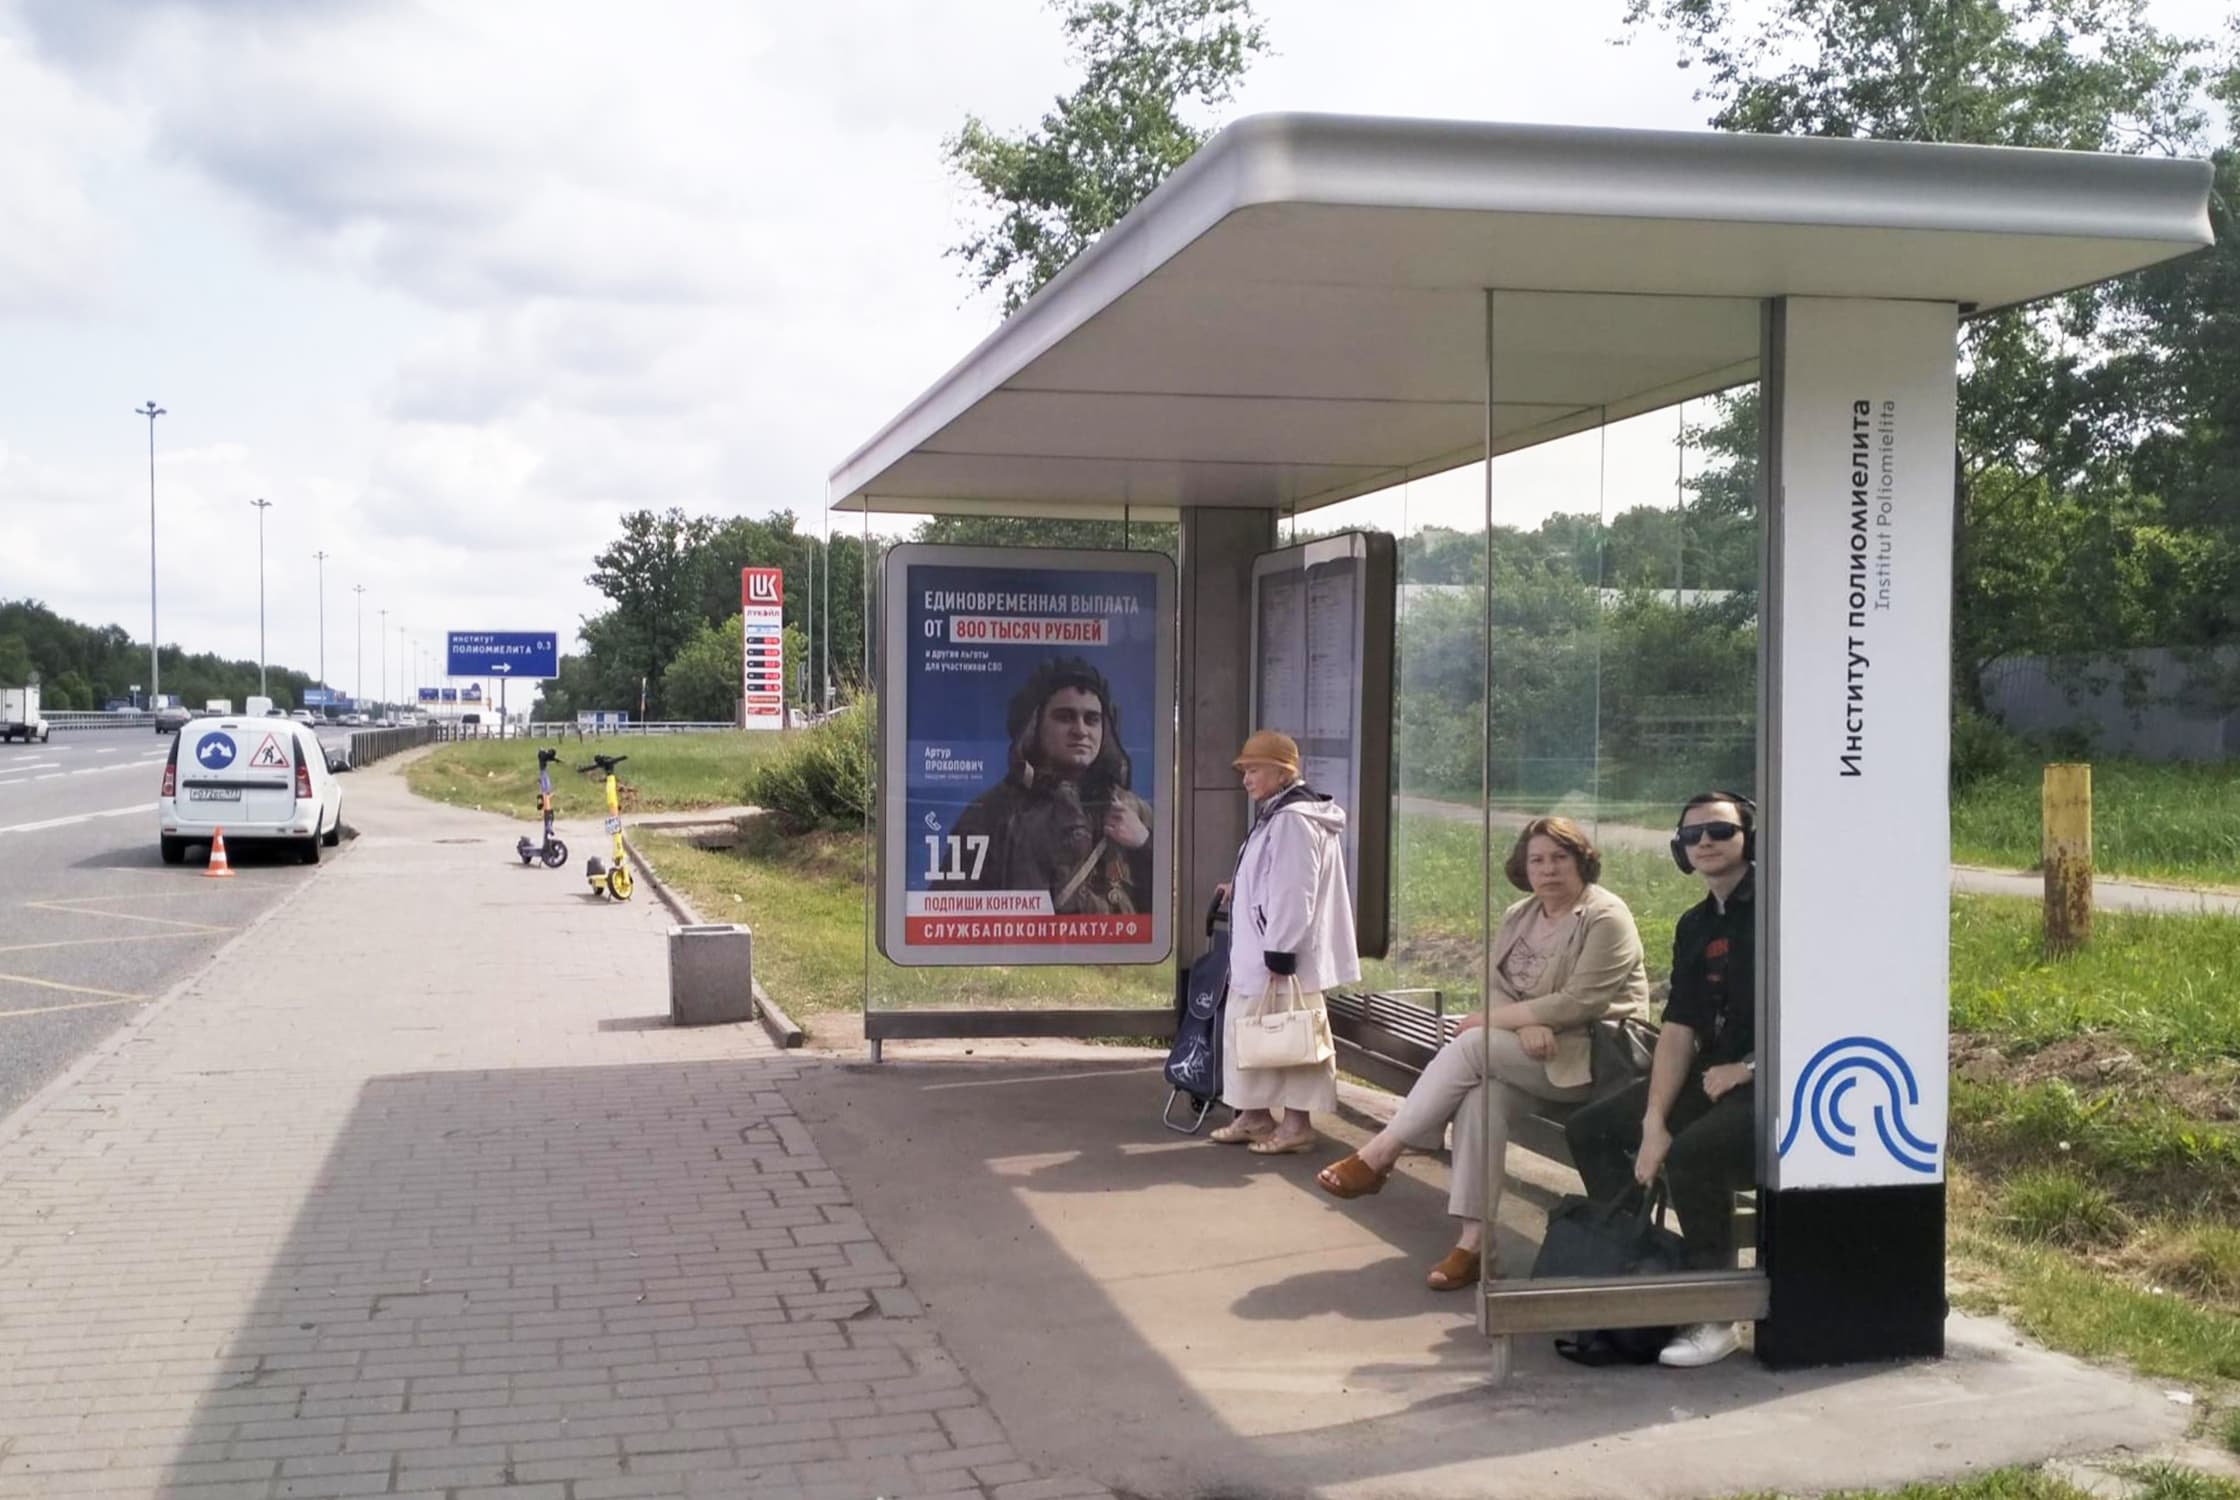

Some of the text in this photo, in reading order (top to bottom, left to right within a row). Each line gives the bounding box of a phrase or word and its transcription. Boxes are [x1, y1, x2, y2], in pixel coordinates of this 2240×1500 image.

[1874, 401, 1895, 611] Institut Poliomielita
[1839, 400, 1871, 777] Институт полиомиелита
[924, 591, 1140, 614] ЕДИНОВРЕМЕННАЯ ВЫПЛАТА
[924, 619, 1102, 641] ОТ 800 ТЫСЯЧ РУБЛЕЙ
[452, 645, 532, 654] ПОЛИОМИЕЛИТА
[925, 746, 952, 759] Артур
[925, 760, 984, 772] ПРОКОПОВИЧ
[924, 835, 990, 881] 117
[924, 896, 1041, 912] ПОДПИШИ КОНТРАКТ
[924, 922, 1138, 938] СЛУЖБАПОКОНТРАКТУ.РФ
